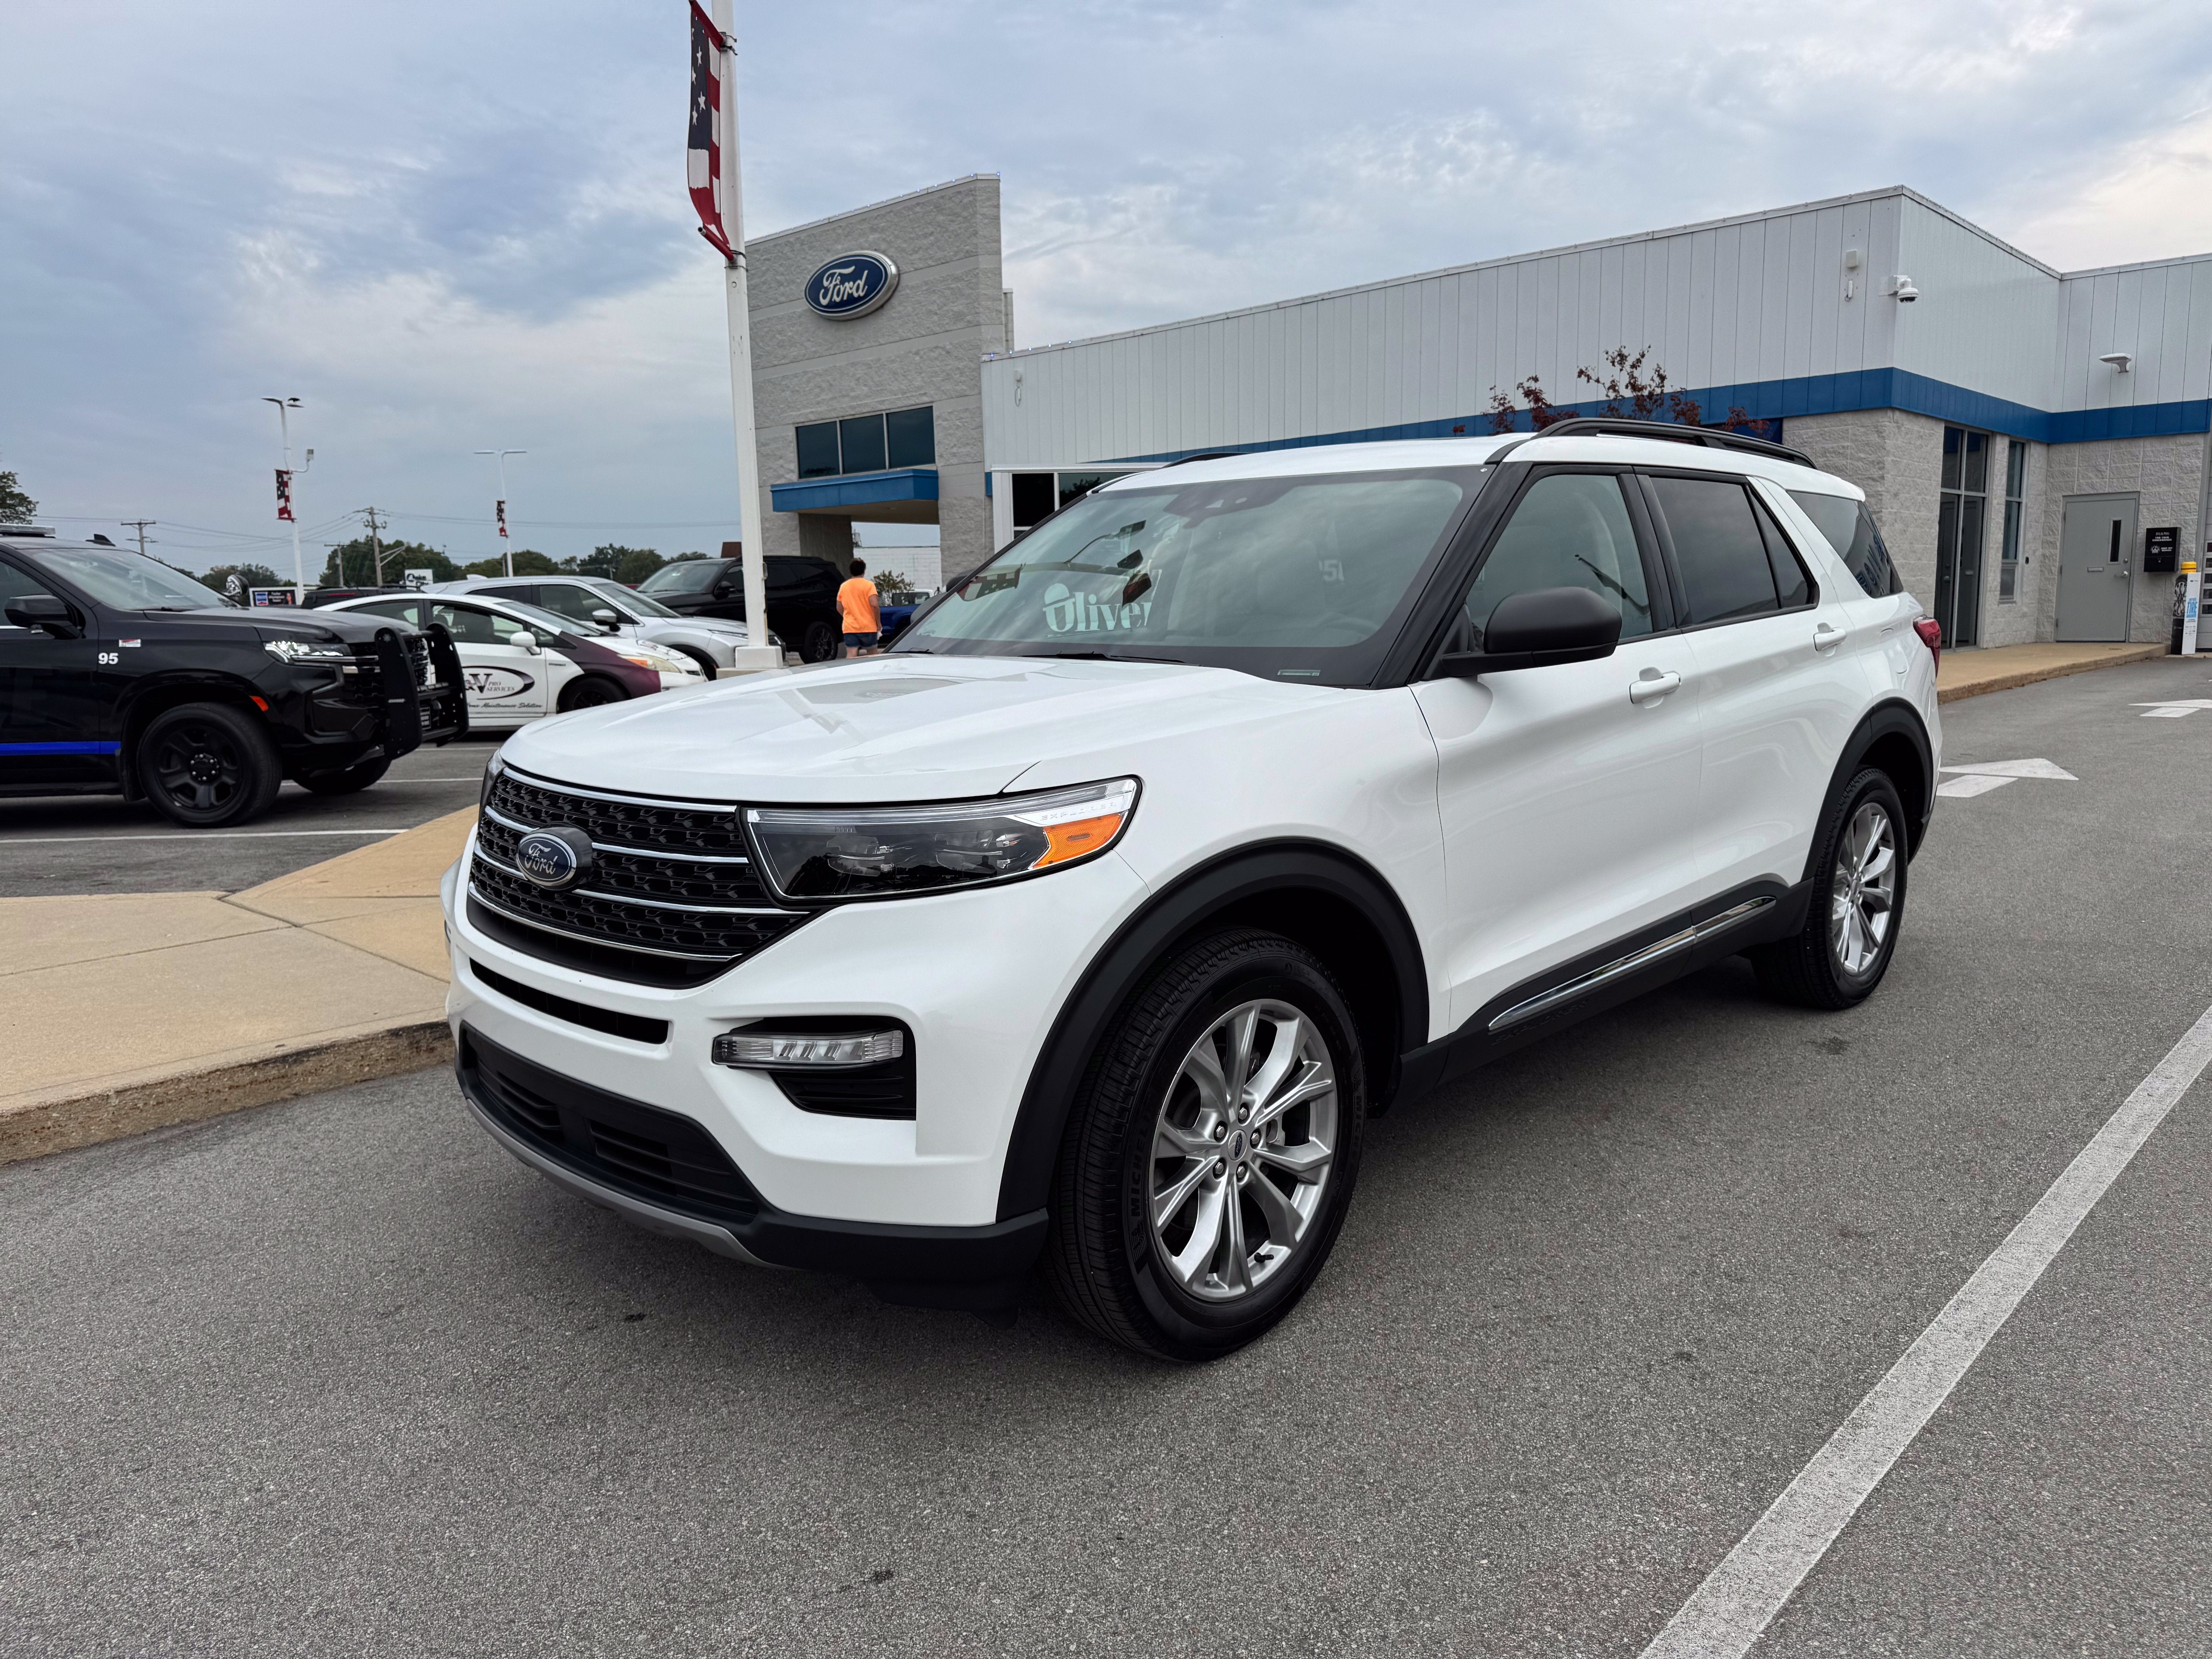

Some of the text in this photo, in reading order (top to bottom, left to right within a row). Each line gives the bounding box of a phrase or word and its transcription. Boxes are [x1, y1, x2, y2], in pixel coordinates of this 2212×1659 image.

[819, 265, 869, 306] Ford
[98, 652, 118, 665] 95
[1040, 802, 1116, 821] EXPLORER
[524, 843, 558, 875] Ford
